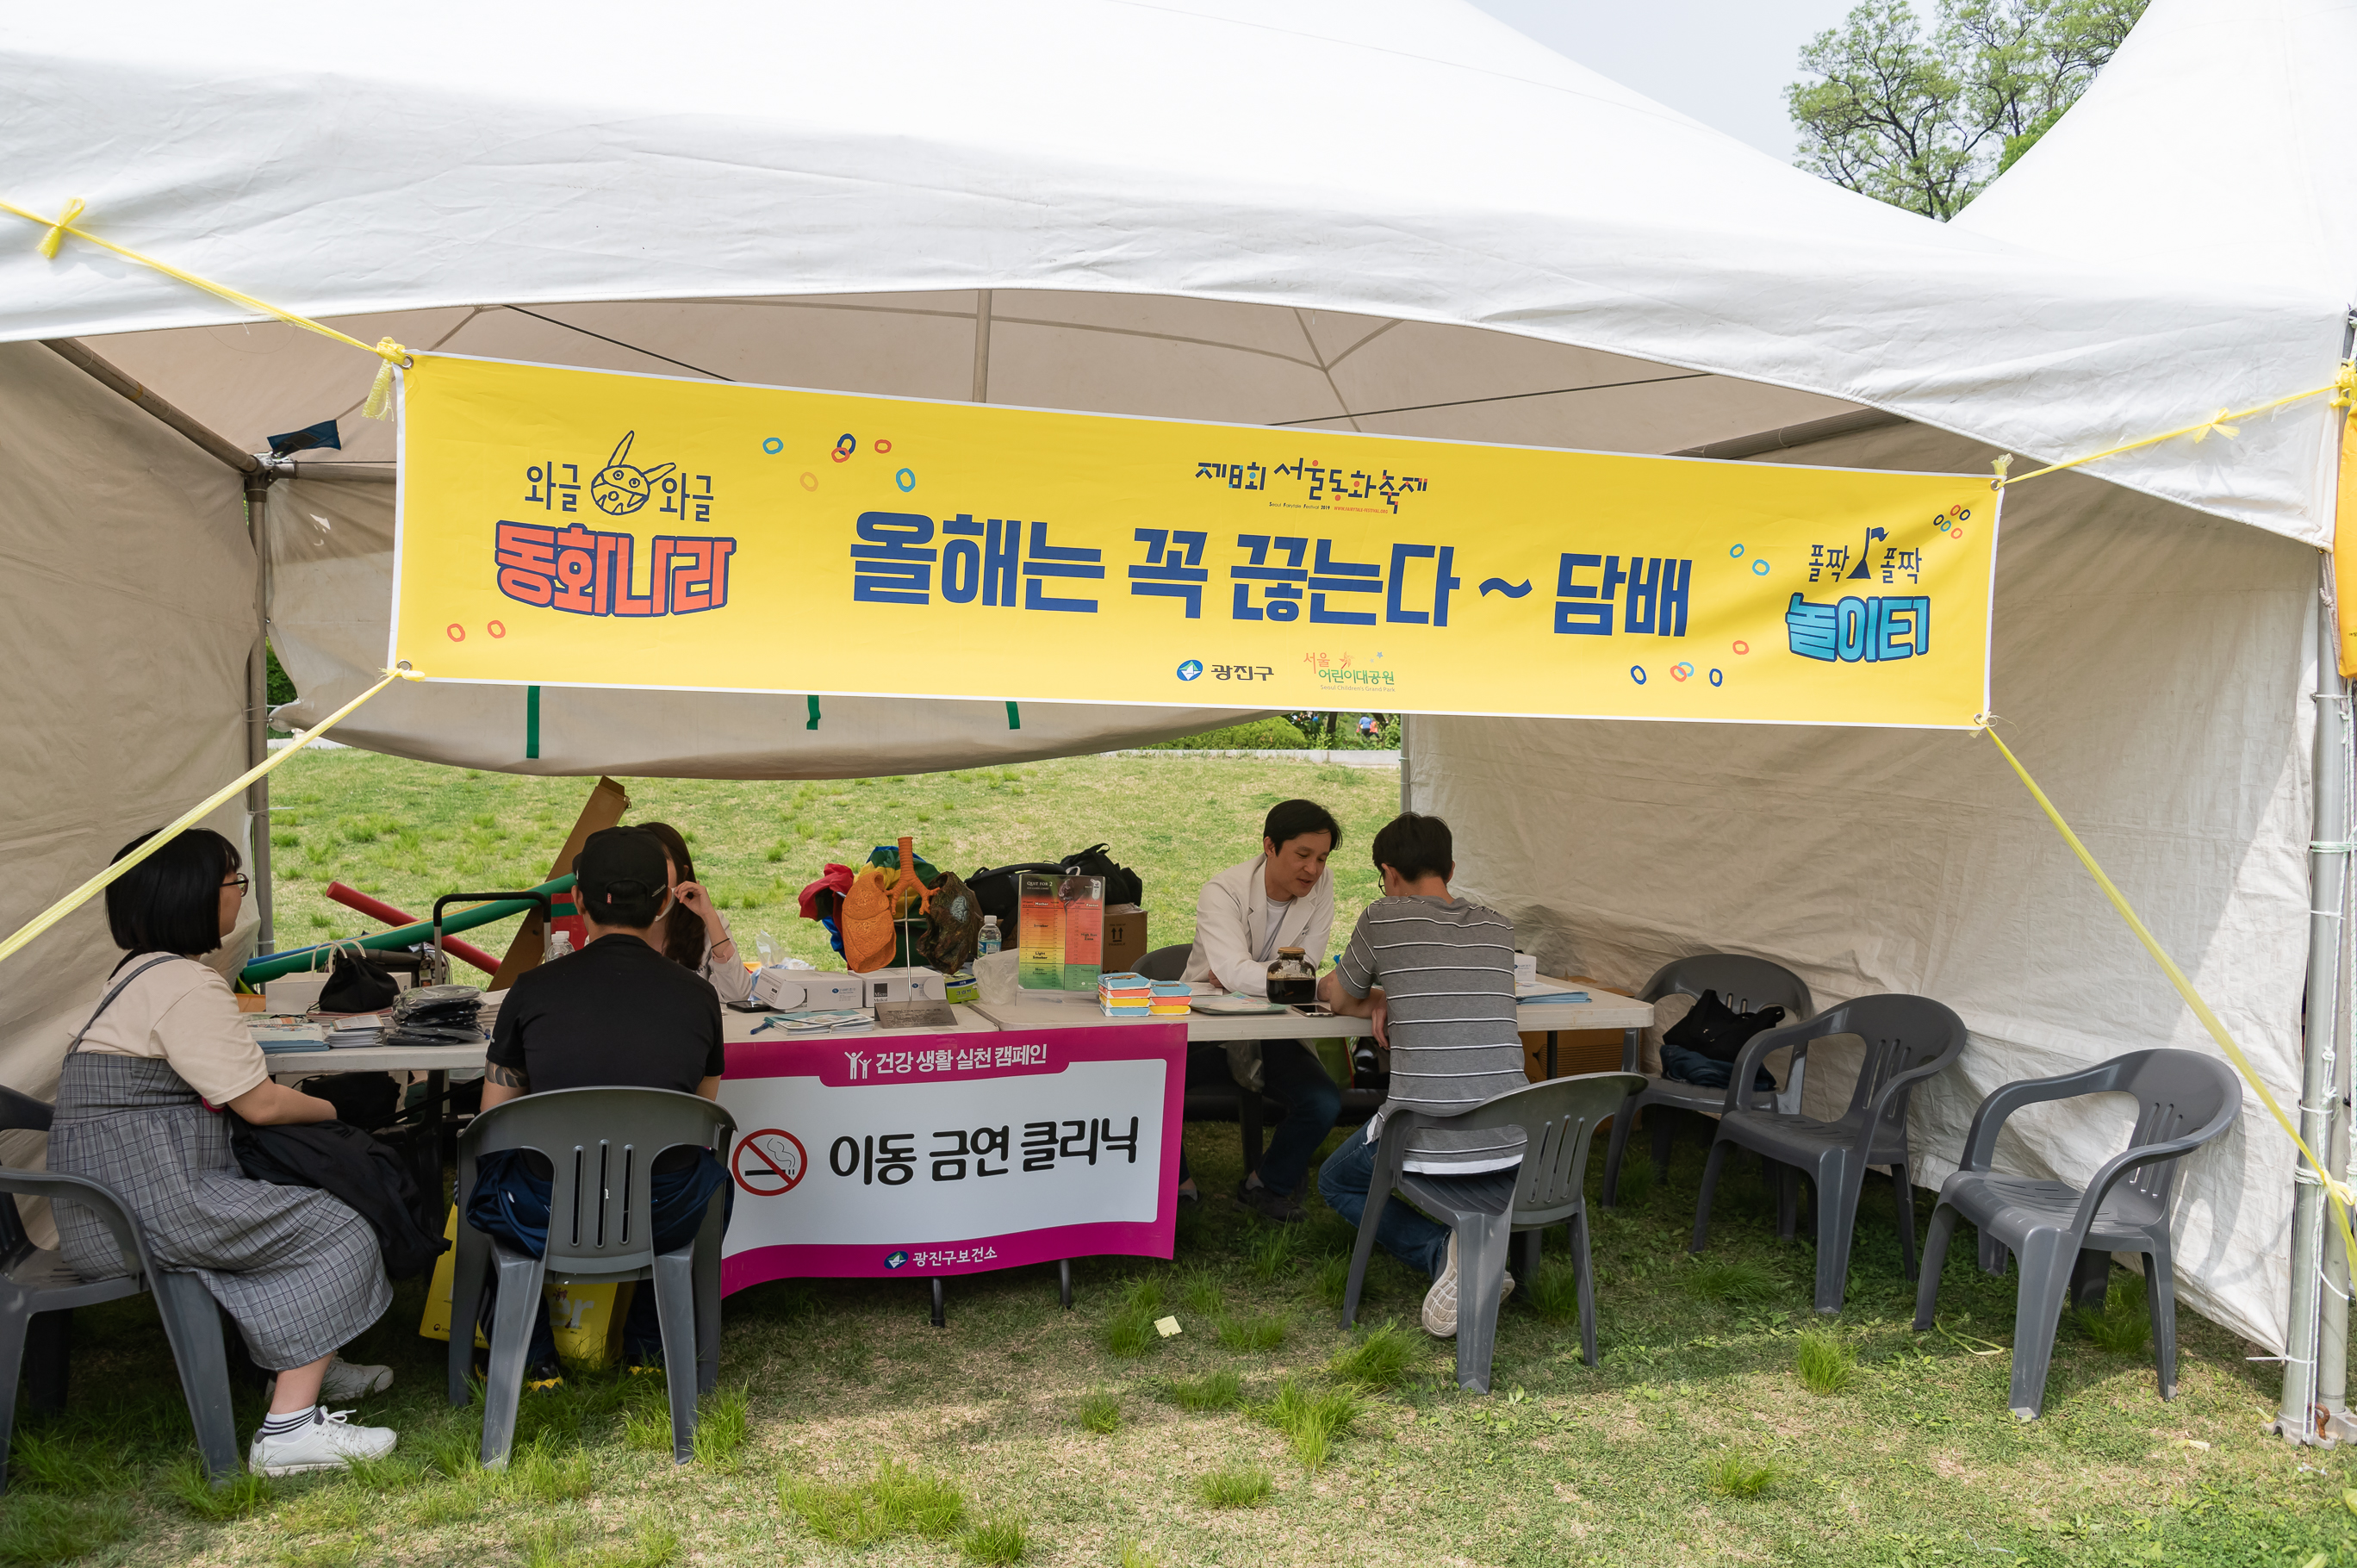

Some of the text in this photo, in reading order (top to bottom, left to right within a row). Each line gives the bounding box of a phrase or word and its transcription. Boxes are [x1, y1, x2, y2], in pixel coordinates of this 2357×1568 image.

[1195, 461, 1266, 491] 제8회
[525, 461, 715, 523] 와글 와글
[494, 519, 737, 618] 동화나라
[849, 511, 1105, 613] 올해는
[1128, 527, 1209, 619] 꼭
[1230, 534, 1461, 627] 끊는다
[1553, 552, 1693, 638] 담배
[1210, 664, 1275, 681] 광진구
[1303, 652, 1331, 675] 서울
[1318, 669, 1395, 685] 어린이대공원
[875, 1043, 1048, 1074] 건강 생활 실천 캠페인
[830, 1116, 1139, 1185] 이동 금연 클리닉
[911, 1247, 998, 1267] 광진구보건소
